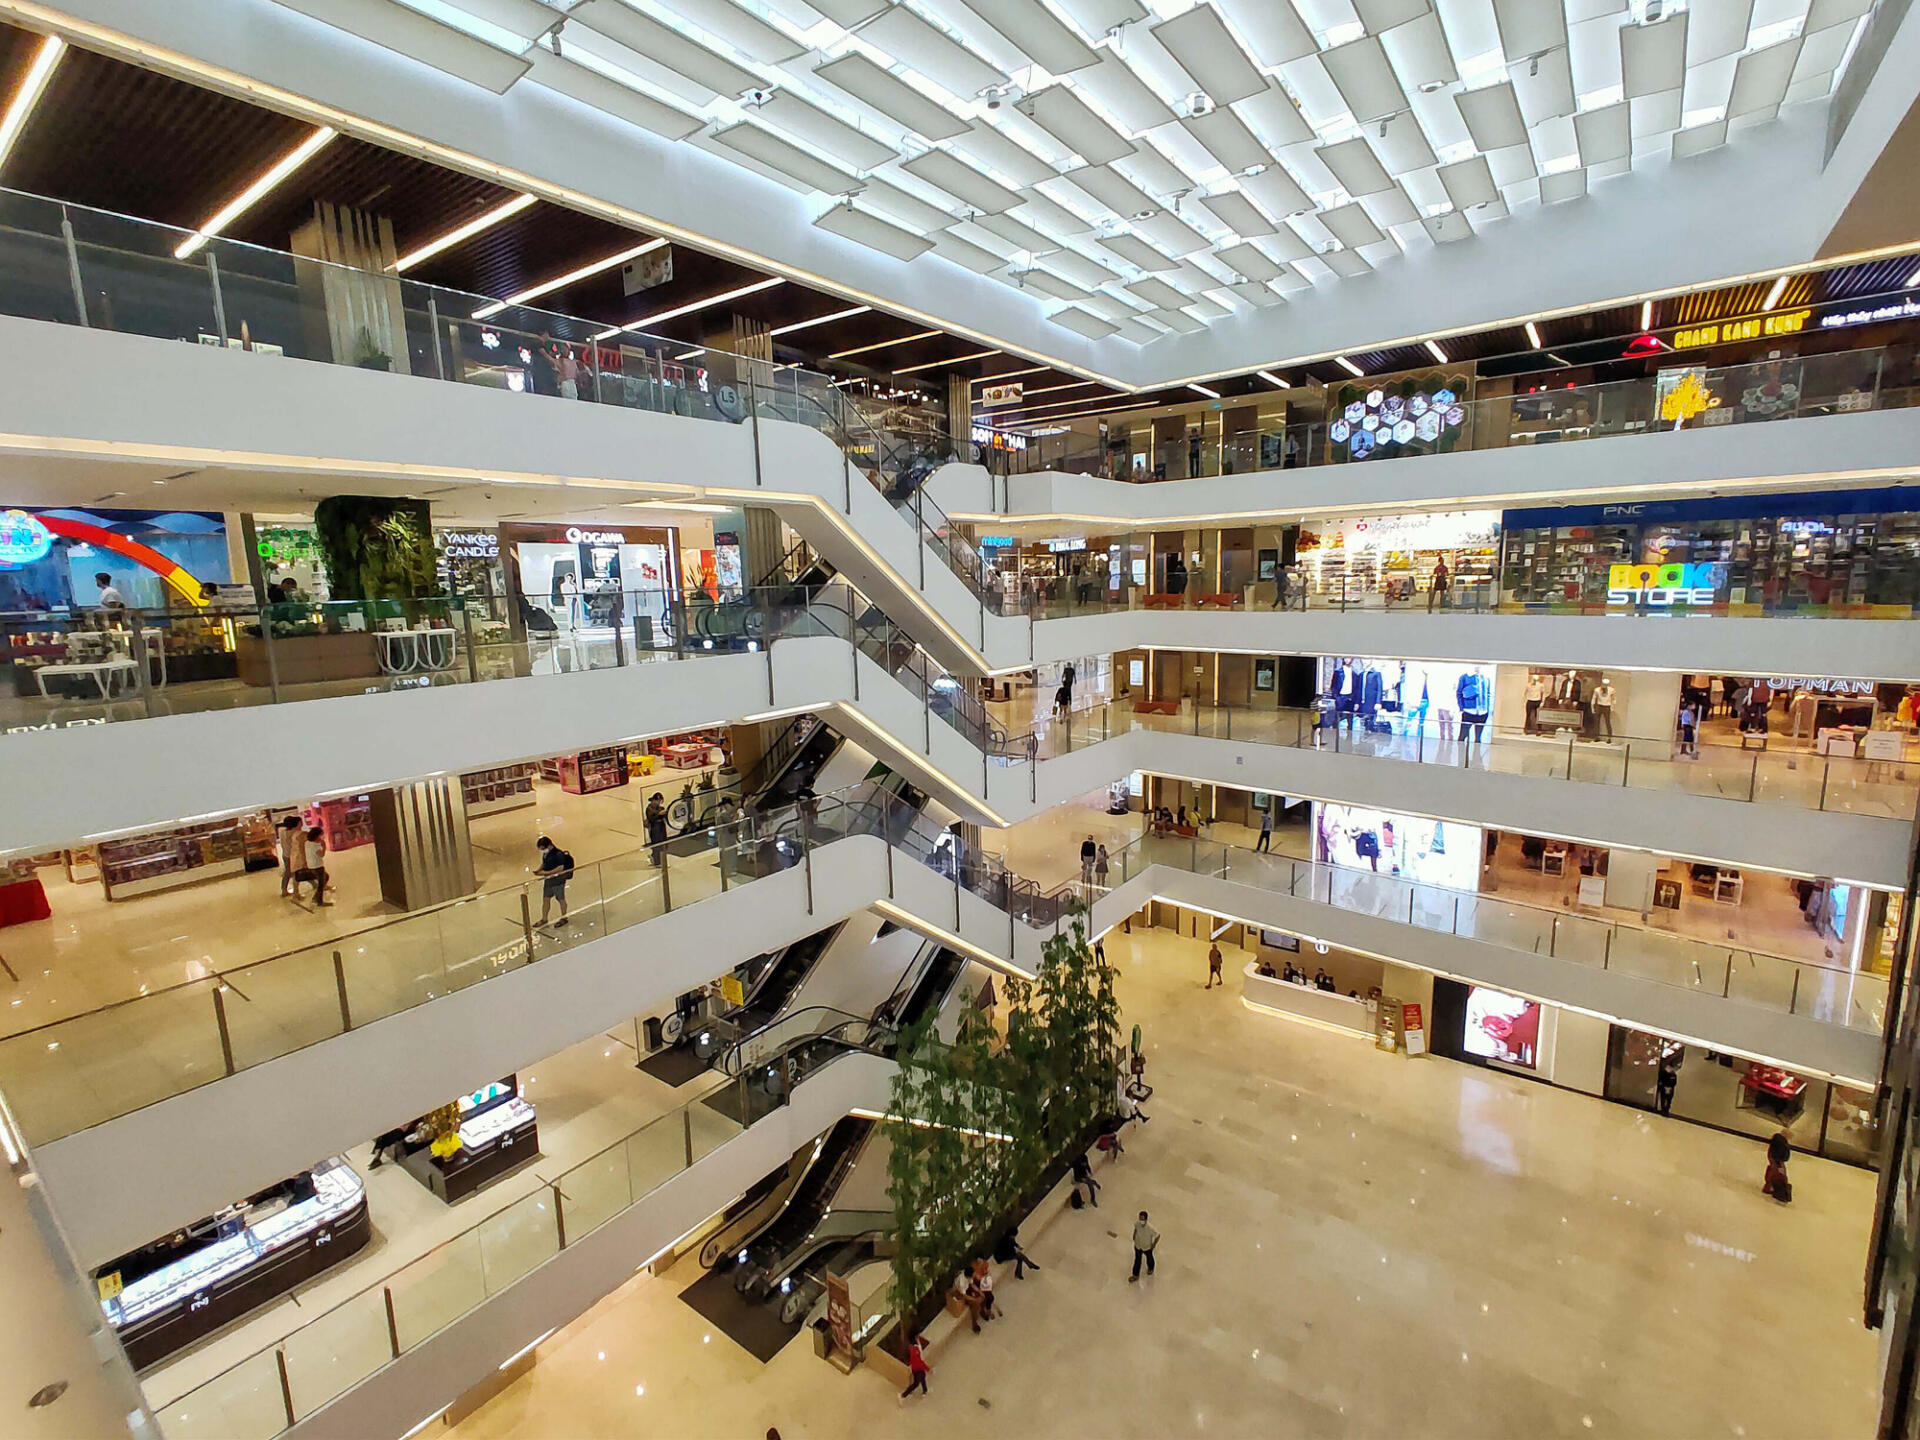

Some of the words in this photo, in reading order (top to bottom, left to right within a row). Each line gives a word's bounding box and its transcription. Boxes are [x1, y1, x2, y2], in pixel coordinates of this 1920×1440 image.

[721, 389, 735, 404] L5
[1603, 504, 1646, 516] PNC
[582, 531, 625, 545] OGAWA
[1608, 562, 1715, 589] BOOK
[1607, 587, 1715, 606] STORE
[673, 806, 687, 819] L3
[668, 1020, 681, 1034] L2
